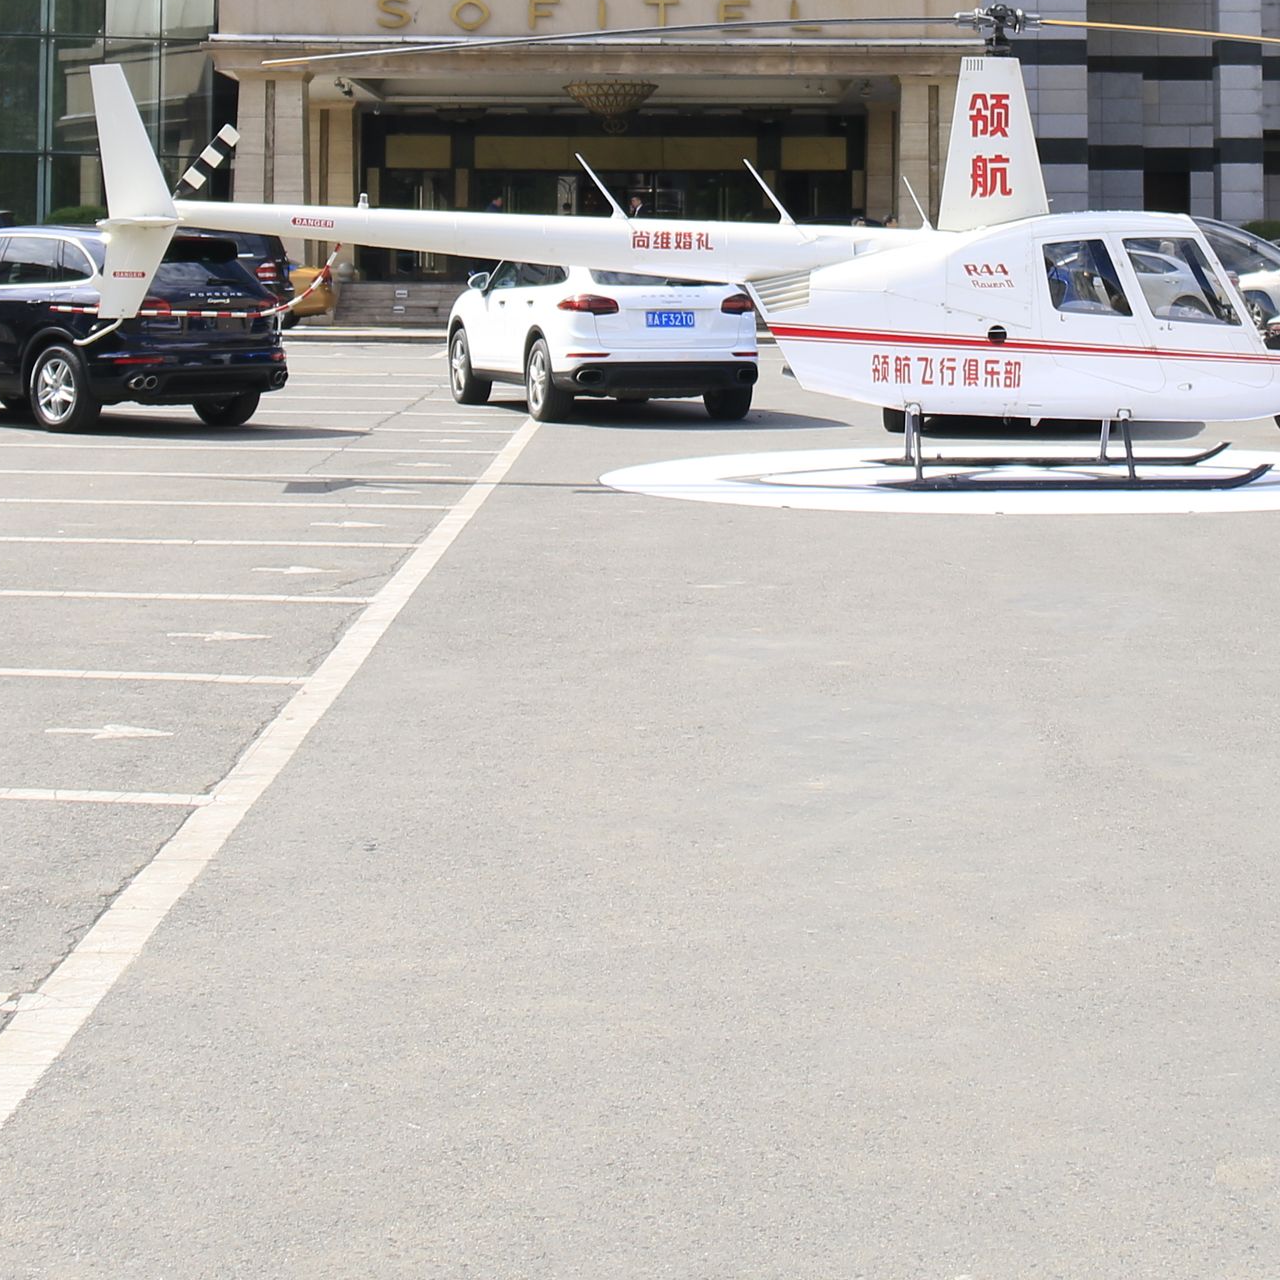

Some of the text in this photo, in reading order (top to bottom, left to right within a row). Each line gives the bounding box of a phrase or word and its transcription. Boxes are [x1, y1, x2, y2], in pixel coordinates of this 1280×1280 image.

[969, 93, 1013, 198] 领航
[295, 218, 332, 228] DANGER
[632, 231, 714, 250] 尚维婚礼
[963, 263, 1009, 276] R44
[872, 354, 1022, 389] 领航飞行俱乐部
